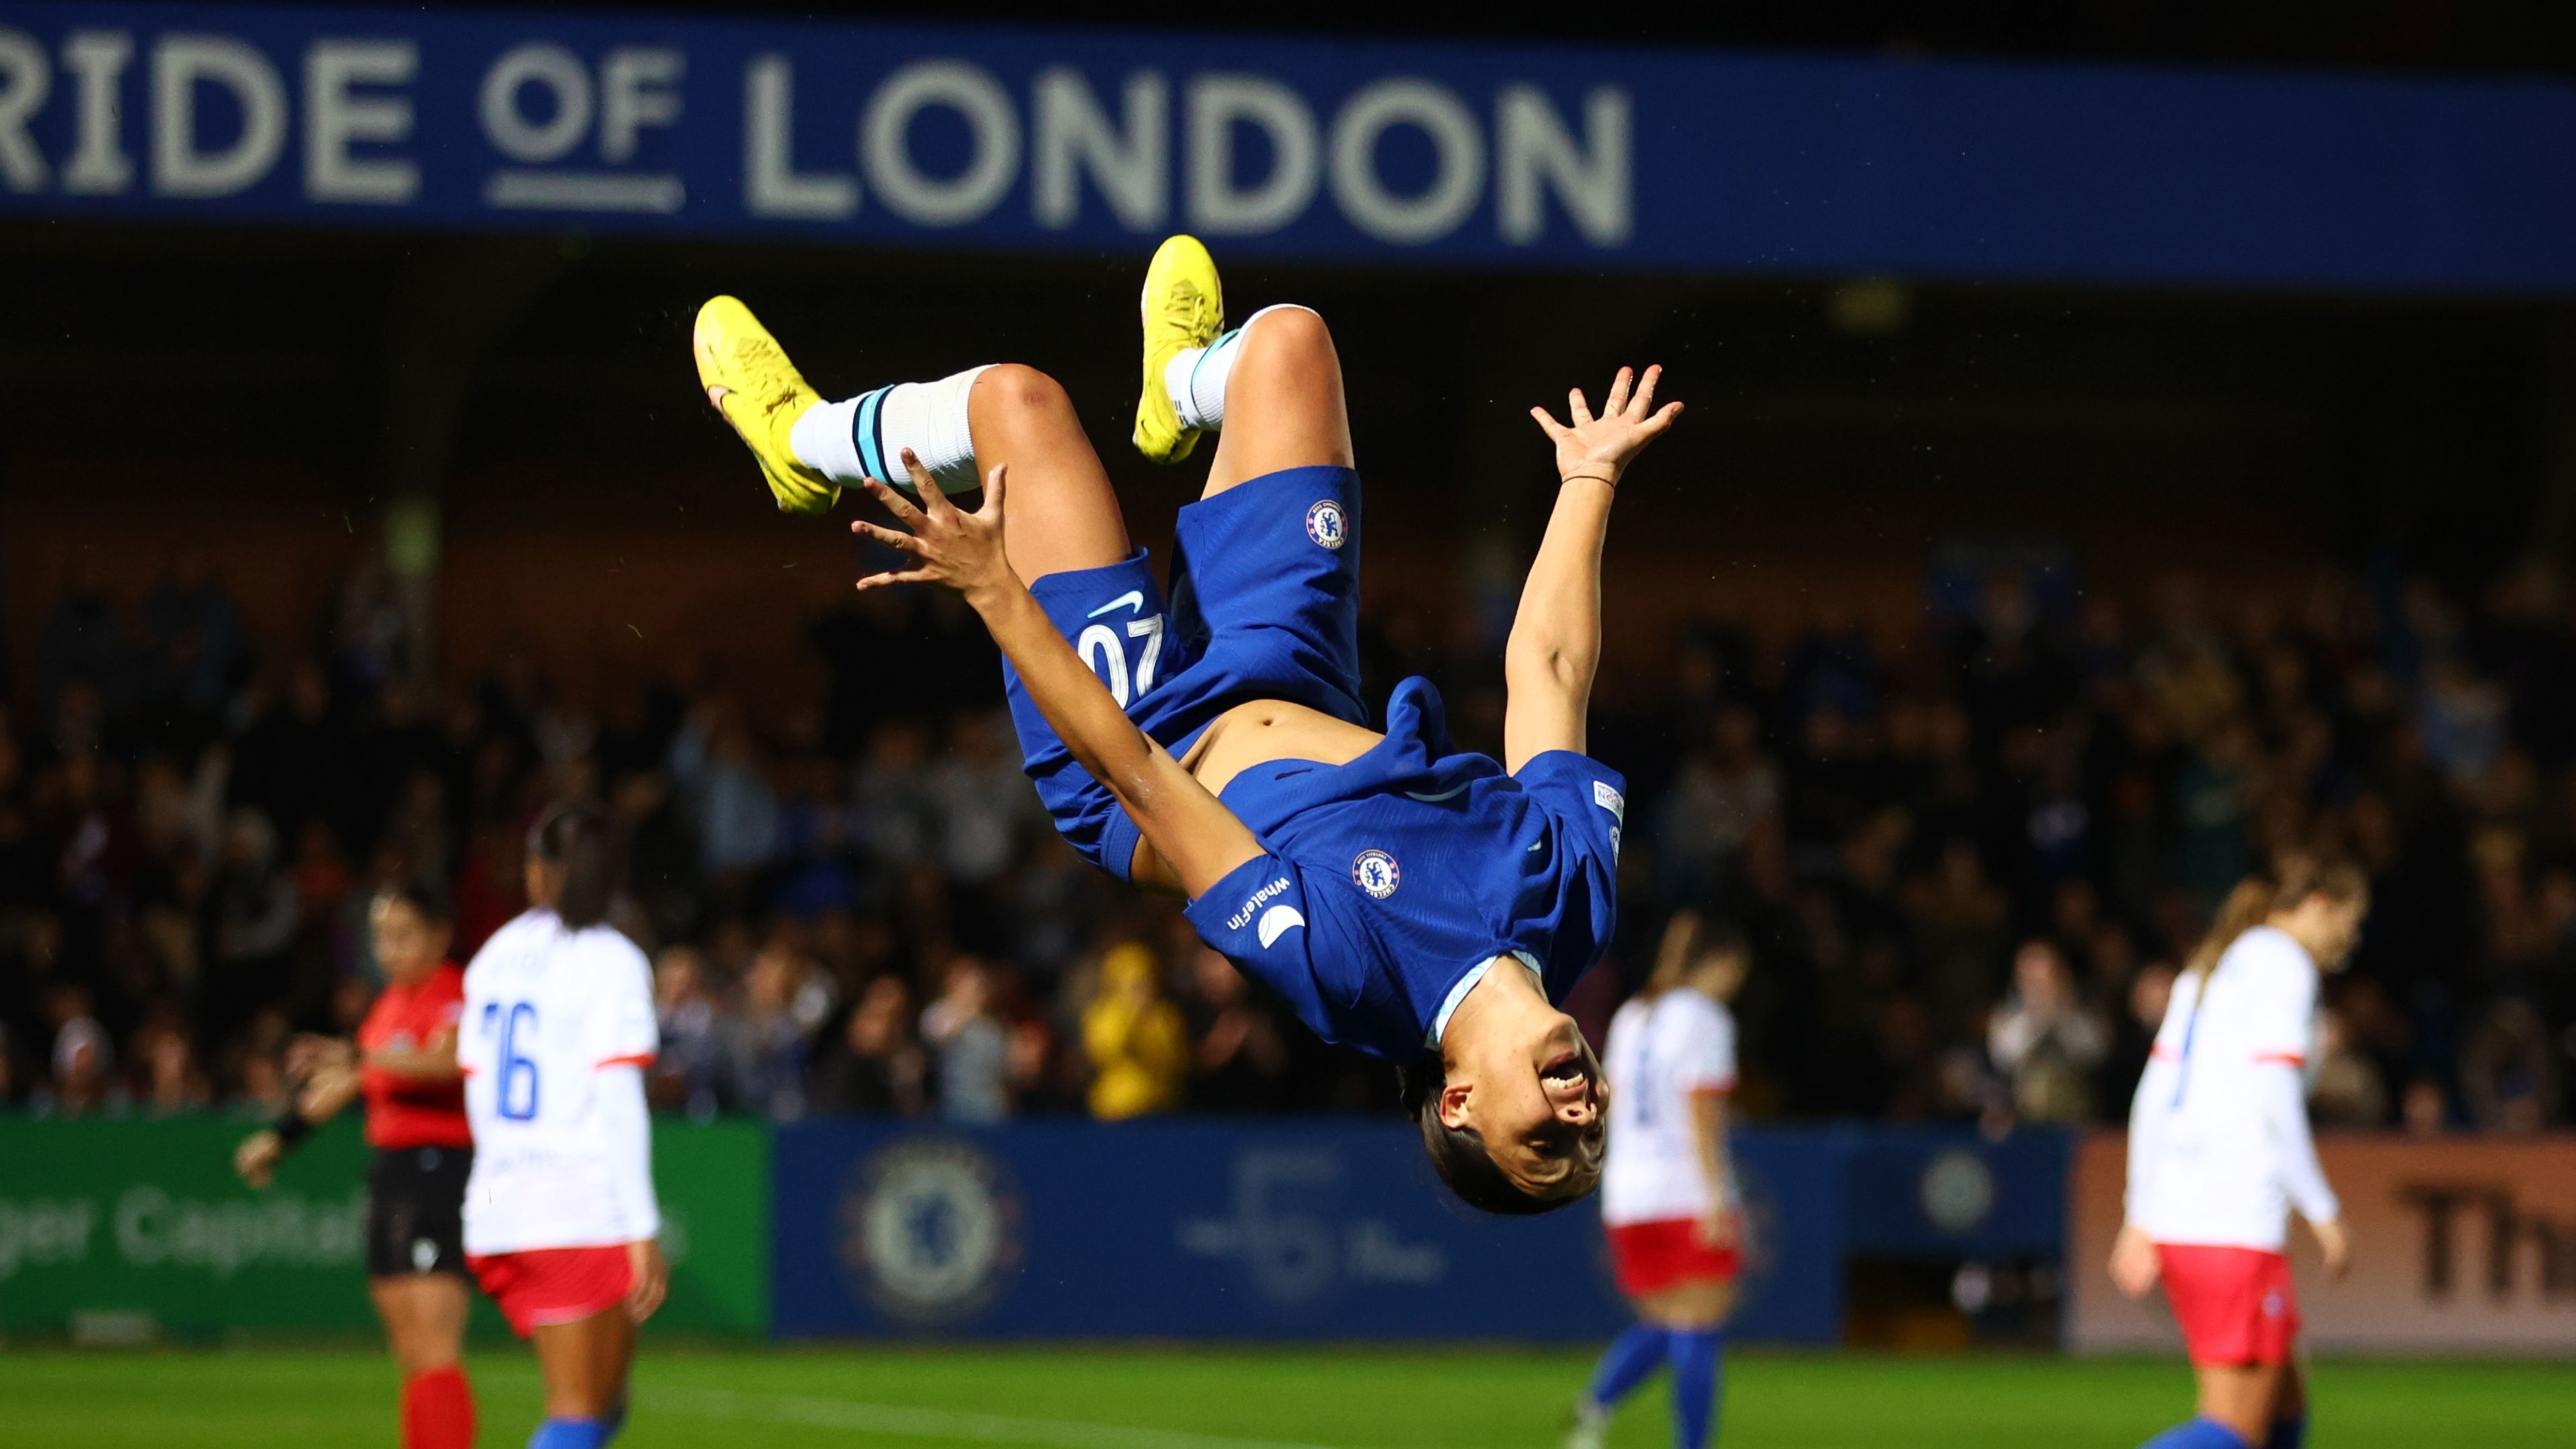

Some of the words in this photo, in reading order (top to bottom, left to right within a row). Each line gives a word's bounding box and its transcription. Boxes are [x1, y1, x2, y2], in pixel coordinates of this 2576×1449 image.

[480, 43, 684, 164] OF
[746, 55, 1633, 245] LONDON
[1318, 537, 1344, 547] CHELSEA
[1226, 877, 1291, 930] WhaleFin
